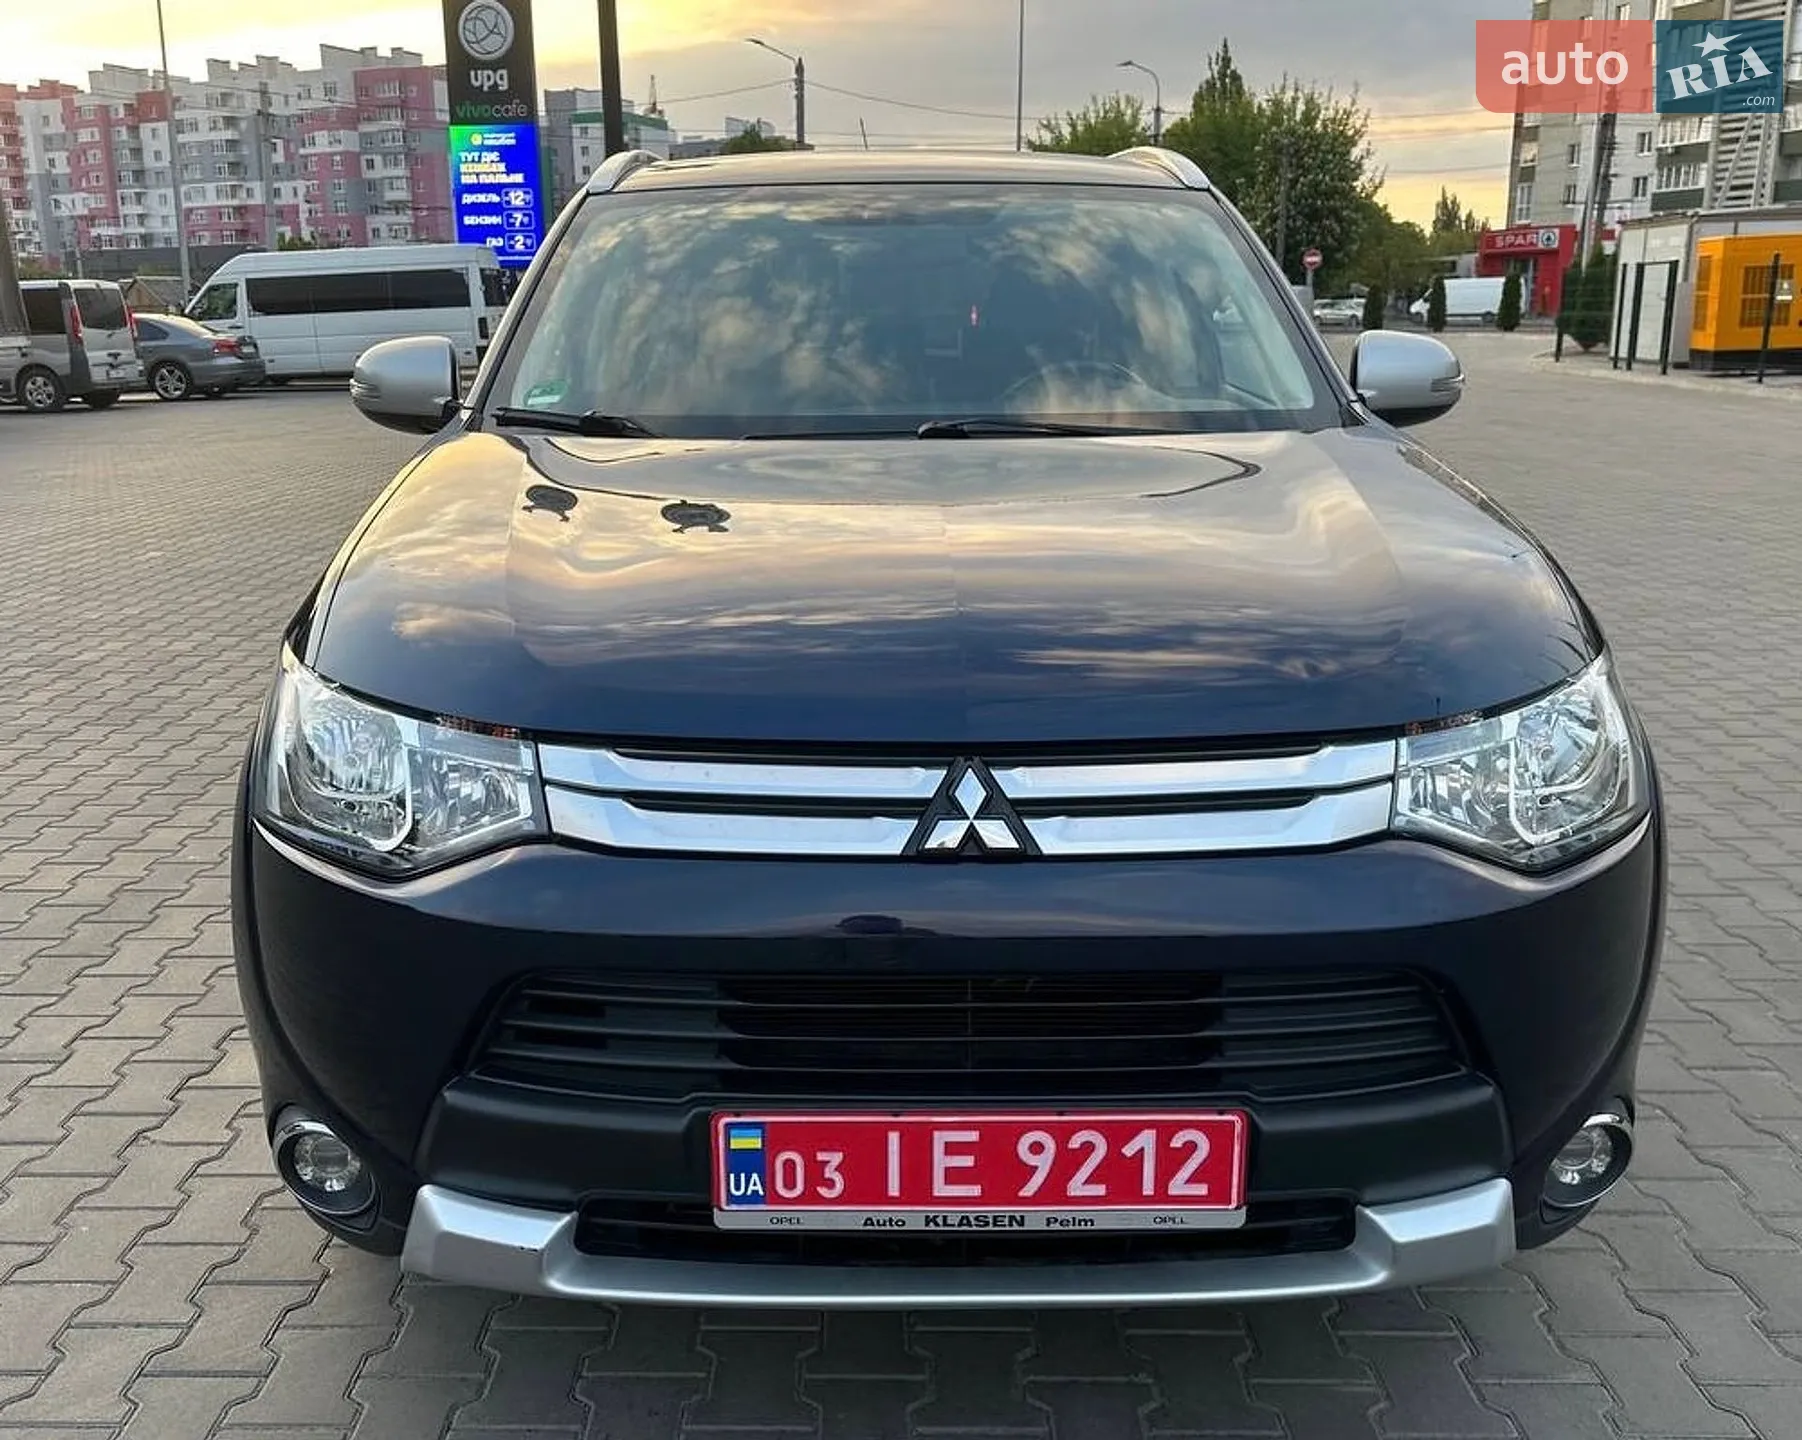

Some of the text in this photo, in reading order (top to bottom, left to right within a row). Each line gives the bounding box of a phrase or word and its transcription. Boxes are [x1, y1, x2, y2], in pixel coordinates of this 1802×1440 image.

[470, 68, 508, 91] upg
[773, 1150, 845, 1199] 03
[1016, 1128, 1211, 1197] 9212
[728, 1172, 765, 1196] UA
[862, 1215, 907, 1228] Auto
[924, 1214, 1026, 1228] KLASEN
